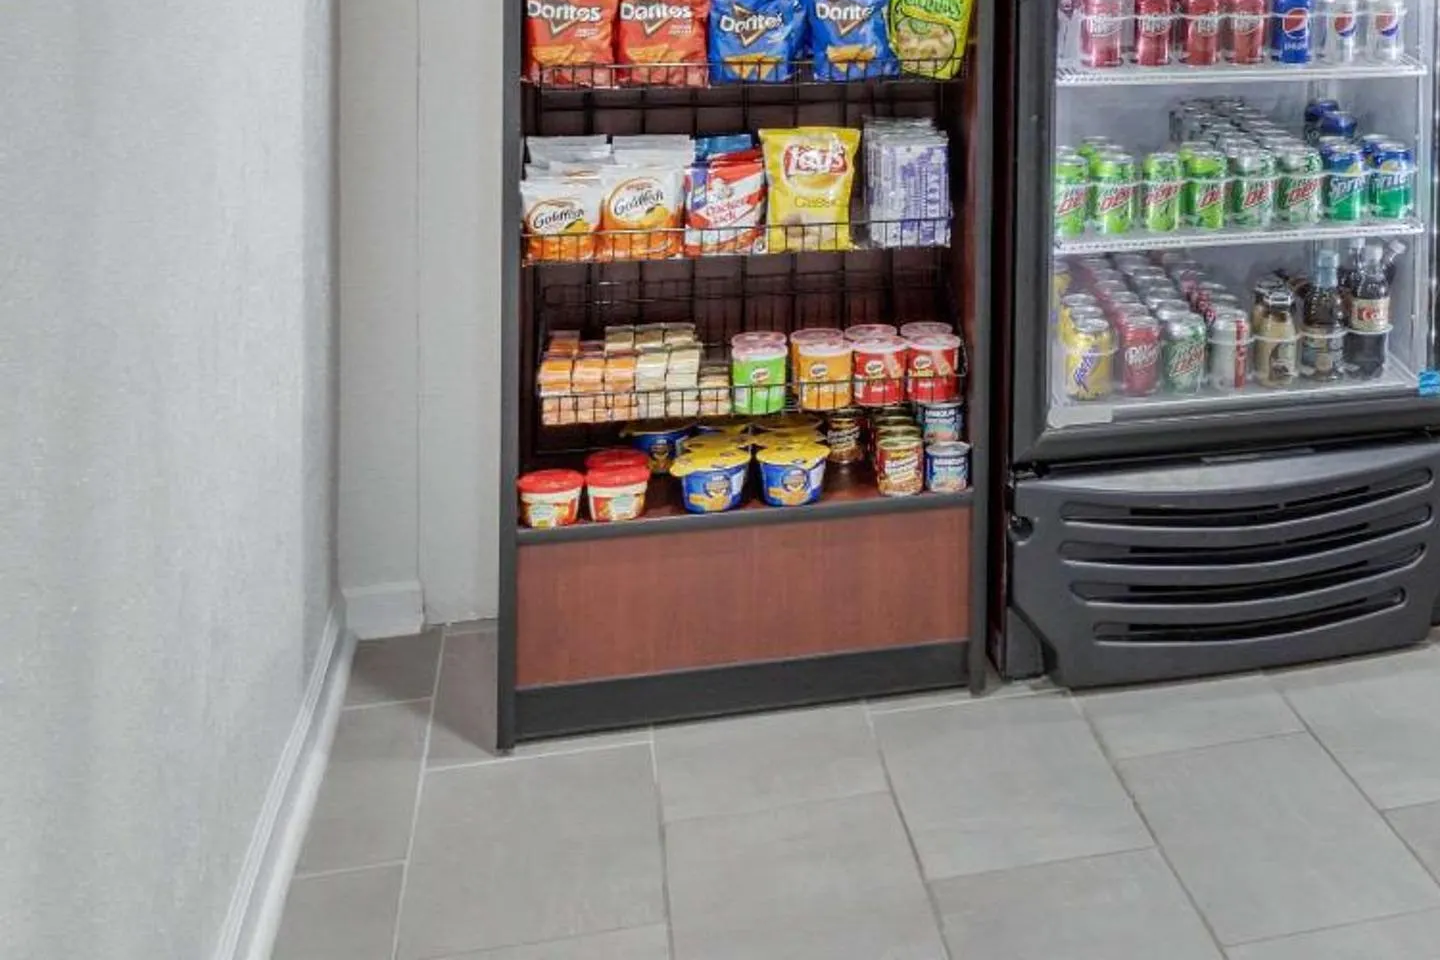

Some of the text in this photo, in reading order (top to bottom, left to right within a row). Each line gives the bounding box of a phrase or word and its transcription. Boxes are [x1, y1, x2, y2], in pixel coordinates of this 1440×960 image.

[527, 0, 602, 22] Doritos
[620, 1, 693, 21] Doritos
[613, 189, 665, 215] Goldfish
[532, 206, 585, 231] Goldfish
